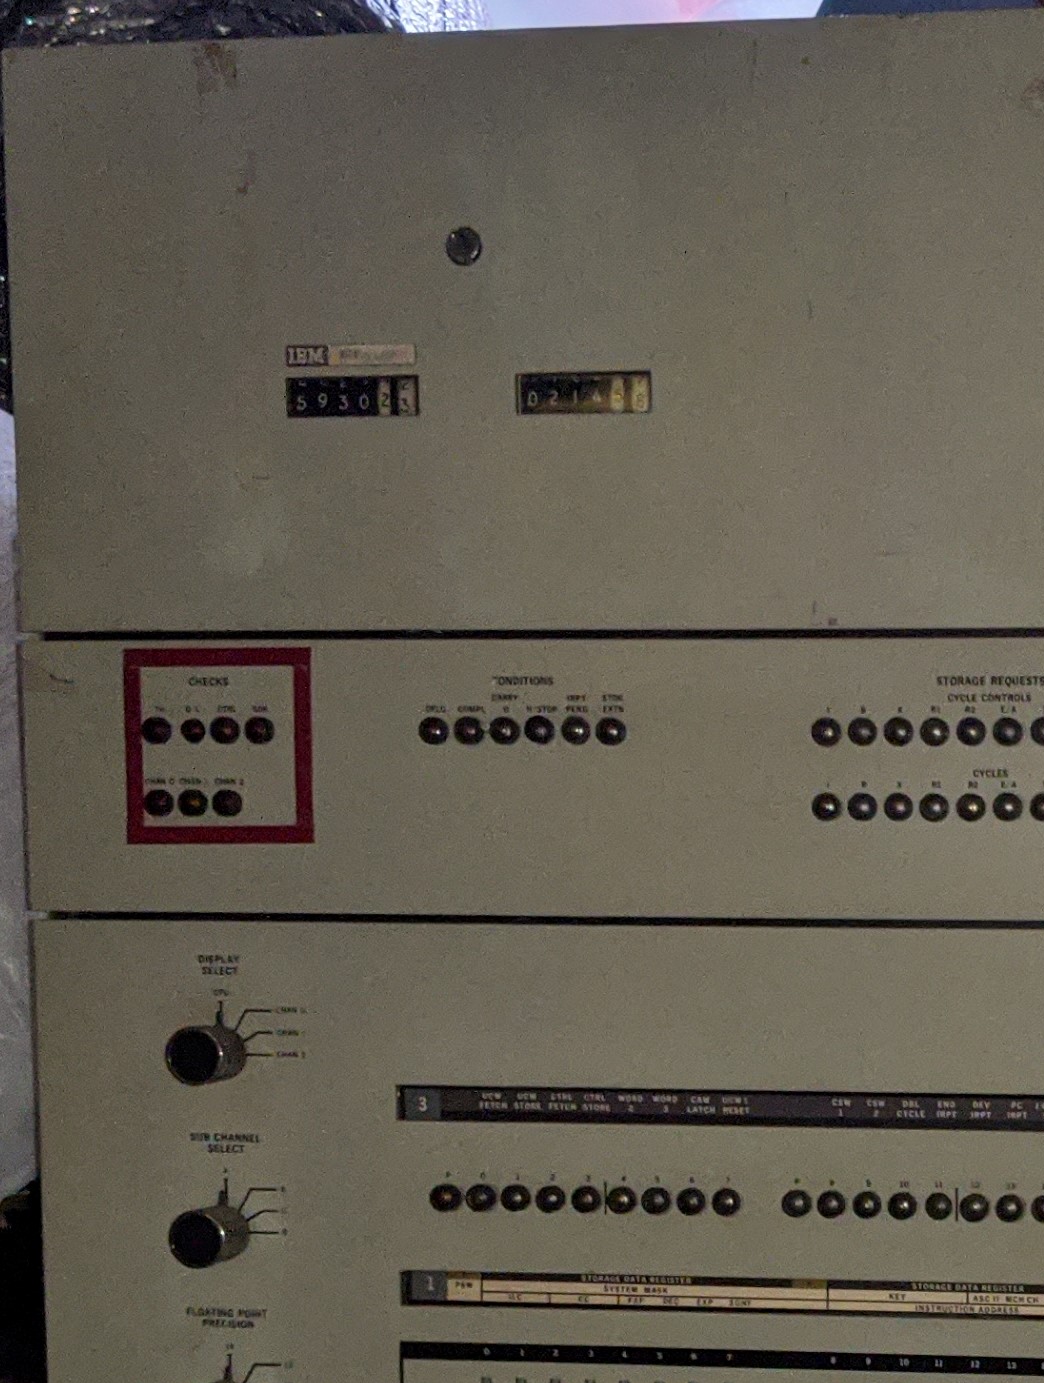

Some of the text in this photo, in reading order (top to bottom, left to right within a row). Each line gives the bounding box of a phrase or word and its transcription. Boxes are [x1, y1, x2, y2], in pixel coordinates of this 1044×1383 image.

[288, 346, 326, 365] IBM
[188, 677, 229, 686] CHECKS
[936, 676, 986, 687] STORAGE
[947, 693, 1032, 703] CYCLE CONTROLS
[973, 769, 1009, 778] CYCLES
[198, 954, 239, 964] DISPLAY
[202, 966, 237, 975] SELECT
[418, 1096, 427, 1111] 3
[618, 1094, 643, 1103] WORD
[652, 1095, 678, 1103] WORD
[832, 1098, 851, 1107] CSW
[866, 1098, 885, 1107] CSW
[902, 1099, 919, 1108] DBL
[479, 1100, 508, 1110] FETCH
[514, 1101, 543, 1111] STORE
[548, 1102, 577, 1112] FETCH
[582, 1103, 611, 1112] STORE
[686, 1104, 716, 1115] LATCH
[896, 1109, 926, 1118] CYCLE
[214, 1132, 259, 1143] CHANNEL
[208, 1144, 245, 1153] SELECT
[426, 1276, 435, 1291] 1
[581, 1274, 692, 1285] STORAGE DATA REGISTER
[604, 1284, 668, 1294] SYSTEM MASK
[911, 1282, 1024, 1294] STORAGE DATA REGISTER
[888, 1292, 906, 1301] KEY
[186, 1306, 234, 1317] FLOATING
[914, 1304, 1019, 1315] INSTRUCTION ADDRESS
[202, 1319, 254, 1328] PRECISION
